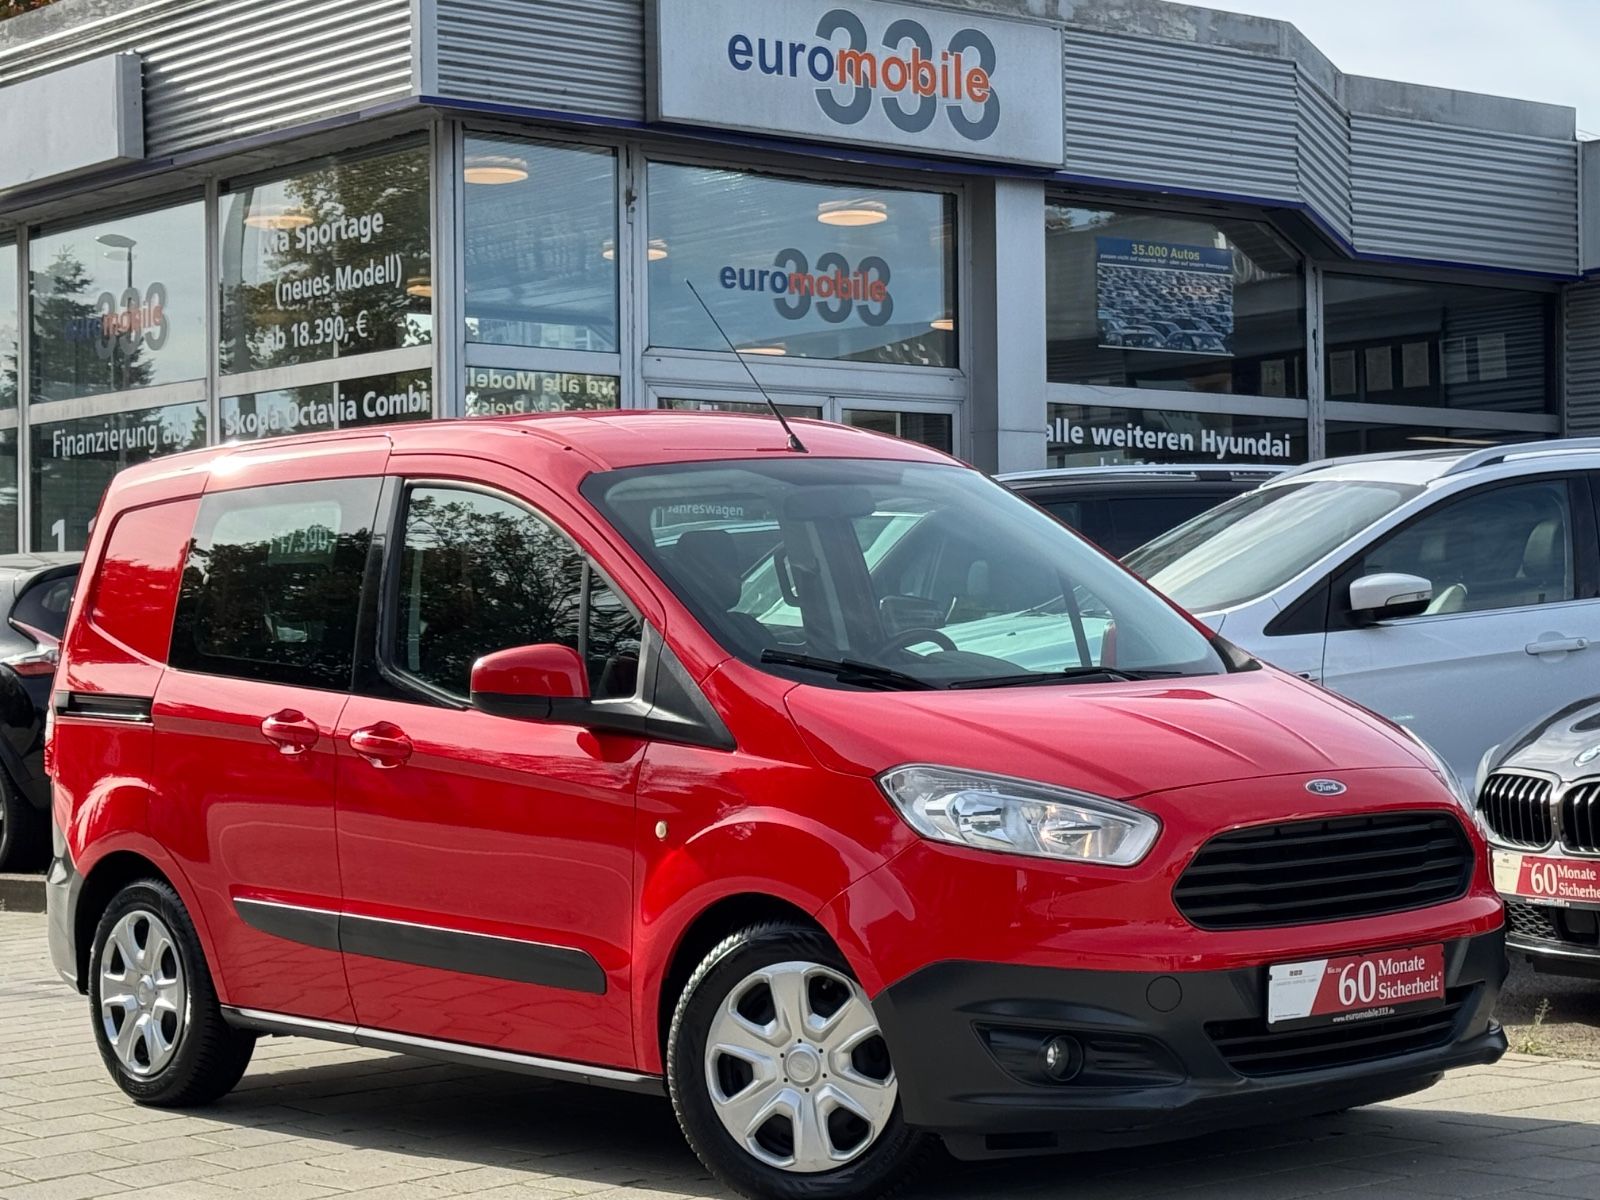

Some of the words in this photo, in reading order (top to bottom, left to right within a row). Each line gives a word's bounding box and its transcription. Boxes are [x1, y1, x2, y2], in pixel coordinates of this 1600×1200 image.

[728, 33, 990, 103] euromobile
[814, 8, 1001, 141] 333
[295, 212, 384, 254] Sportage
[1131, 243, 1168, 258] 35.000
[1170, 247, 1200, 261] Autos
[275, 273, 331, 311] (neues
[335, 253, 402, 292] Modell)
[720, 265, 888, 303] euromobile
[264, 325, 286, 351] ab
[287, 393, 357, 428] Octavia
[363, 383, 430, 418] Combi
[53, 423, 158, 457] Finanzierung
[1046, 418, 1084, 444] alle
[1091, 422, 1194, 452] weiteren
[1201, 428, 1291, 460] Hyundai
[1530, 862, 1558, 895] 60
[1557, 864, 1597, 881] Monate
[1338, 960, 1376, 1006] 60
[1378, 955, 1425, 977] Monate
